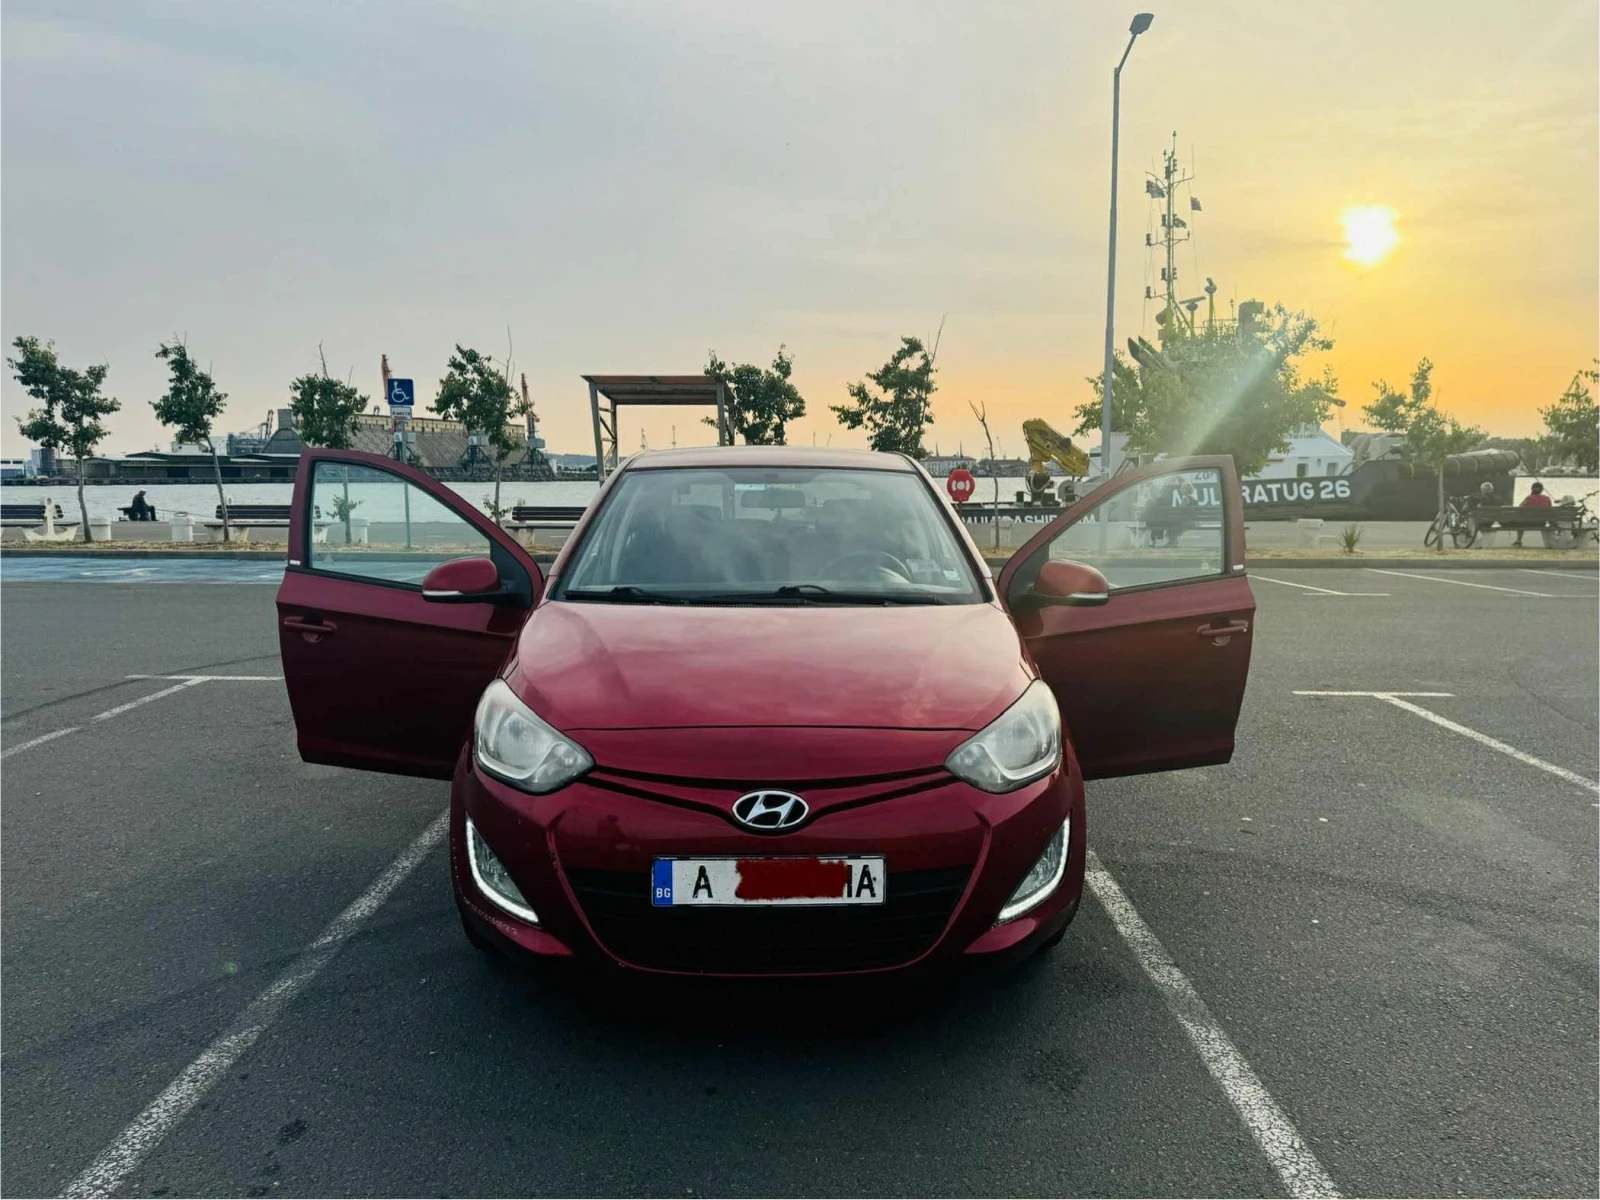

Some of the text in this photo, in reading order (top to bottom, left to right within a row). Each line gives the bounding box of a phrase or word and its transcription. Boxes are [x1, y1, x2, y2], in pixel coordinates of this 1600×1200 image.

[1319, 480, 1351, 499] 26
[692, 865, 714, 899] A
[656, 887, 671, 899] BG
